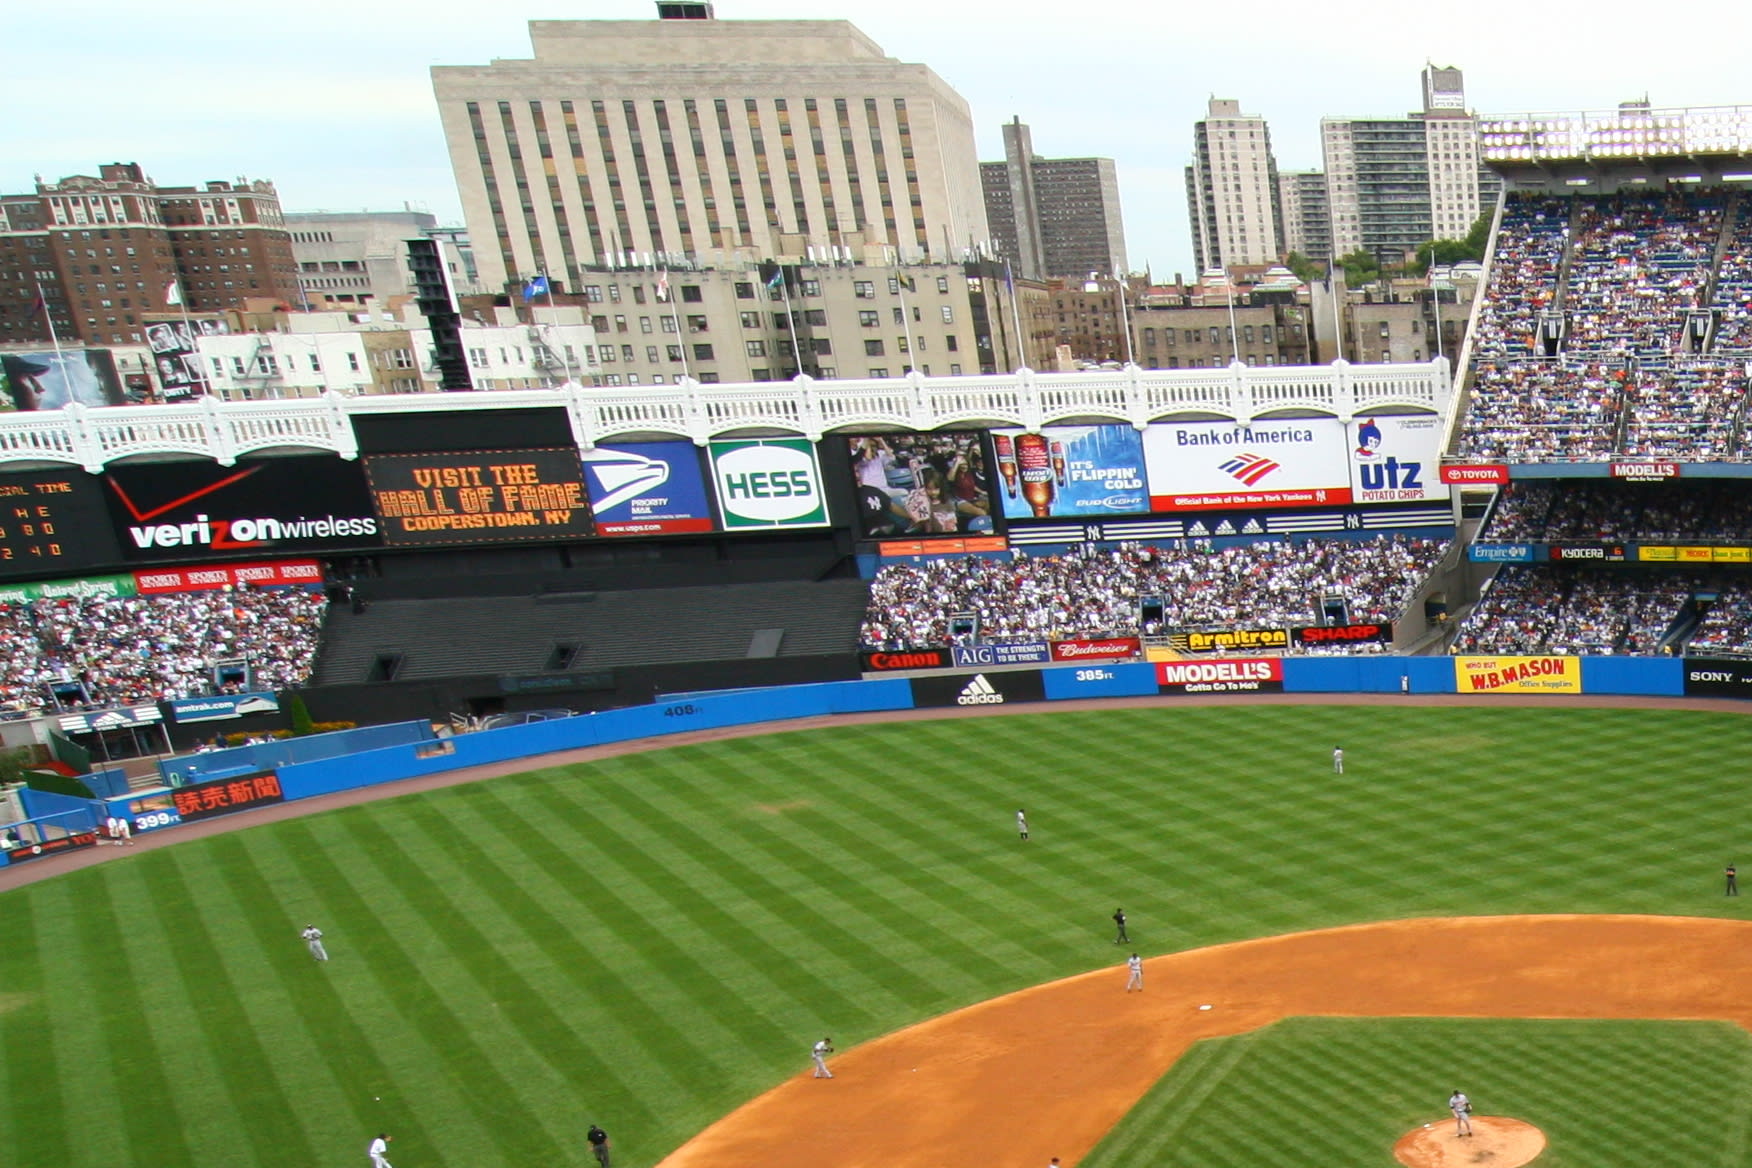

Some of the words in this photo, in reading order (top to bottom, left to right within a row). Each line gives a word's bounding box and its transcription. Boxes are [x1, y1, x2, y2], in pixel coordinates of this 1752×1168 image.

[1176, 430, 1221, 446] Bank
[1222, 428, 1240, 445] of
[1243, 426, 1314, 444] America
[1070, 460, 1094, 470] IT'S
[1615, 464, 1675, 477] MODELL'S
[413, 466, 481, 488] VISIT
[489, 464, 540, 485] THE
[1071, 467, 1138, 481] FLIPPIN'
[1360, 457, 1423, 490] utz
[1461, 470, 1500, 479] TOYOTA
[36, 482, 73, 494] TIME
[726, 470, 812, 500] HESS
[1104, 479, 1143, 490] COLD
[378, 489, 455, 517] HALL
[458, 486, 494, 514] OF
[501, 482, 585, 512] FAME
[1175, 497, 1201, 506] Official
[1203, 496, 1223, 505] Bank
[1223, 496, 1233, 504] of
[1233, 495, 1246, 504] the
[1247, 494, 1263, 503] New
[1264, 494, 1282, 503] York
[1283, 493, 1313, 502] Yankees
[1362, 490, 1396, 501] POTATO
[1398, 489, 1425, 499] CHIPS
[15, 508, 29, 519] H
[37, 506, 51, 517] E
[403, 511, 541, 532] COOPERSTOWN,
[546, 510, 572, 525] NY
[605, 524, 662, 533] www.usps.com
[1475, 546, 1507, 559] Empire
[1561, 548, 1604, 560] KYOCERA
[187, 570, 228, 580] SPORTS
[234, 567, 274, 578] SPORTS
[280, 564, 318, 575] SPORTS
[139, 573, 181, 584] SPORTS
[1188, 630, 1287, 646] Armitron
[1302, 624, 1380, 642] SHARP
[996, 646, 1010, 655] THE
[1010, 644, 1047, 655] STRENGTH
[1057, 642, 1130, 657] Budweiser
[870, 650, 942, 670] Canon
[960, 648, 993, 665] AIG
[997, 654, 1007, 663] TO
[1007, 654, 1017, 662] BE
[1076, 669, 1104, 682] 385
[1166, 662, 1272, 683] MODELL'S
[1690, 671, 1733, 683] SONY
[1185, 682, 1212, 692] Gotta
[1215, 682, 1227, 691] Go
[1227, 682, 1239, 690] To
[1519, 680, 1540, 688] Office
[1542, 680, 1573, 690] Supplies
[958, 693, 1004, 706] adidas
[176, 700, 235, 714] amtrak.com
[664, 704, 694, 718] 408
[174, 774, 283, 816] 読売新聞
[136, 812, 170, 831] 399
